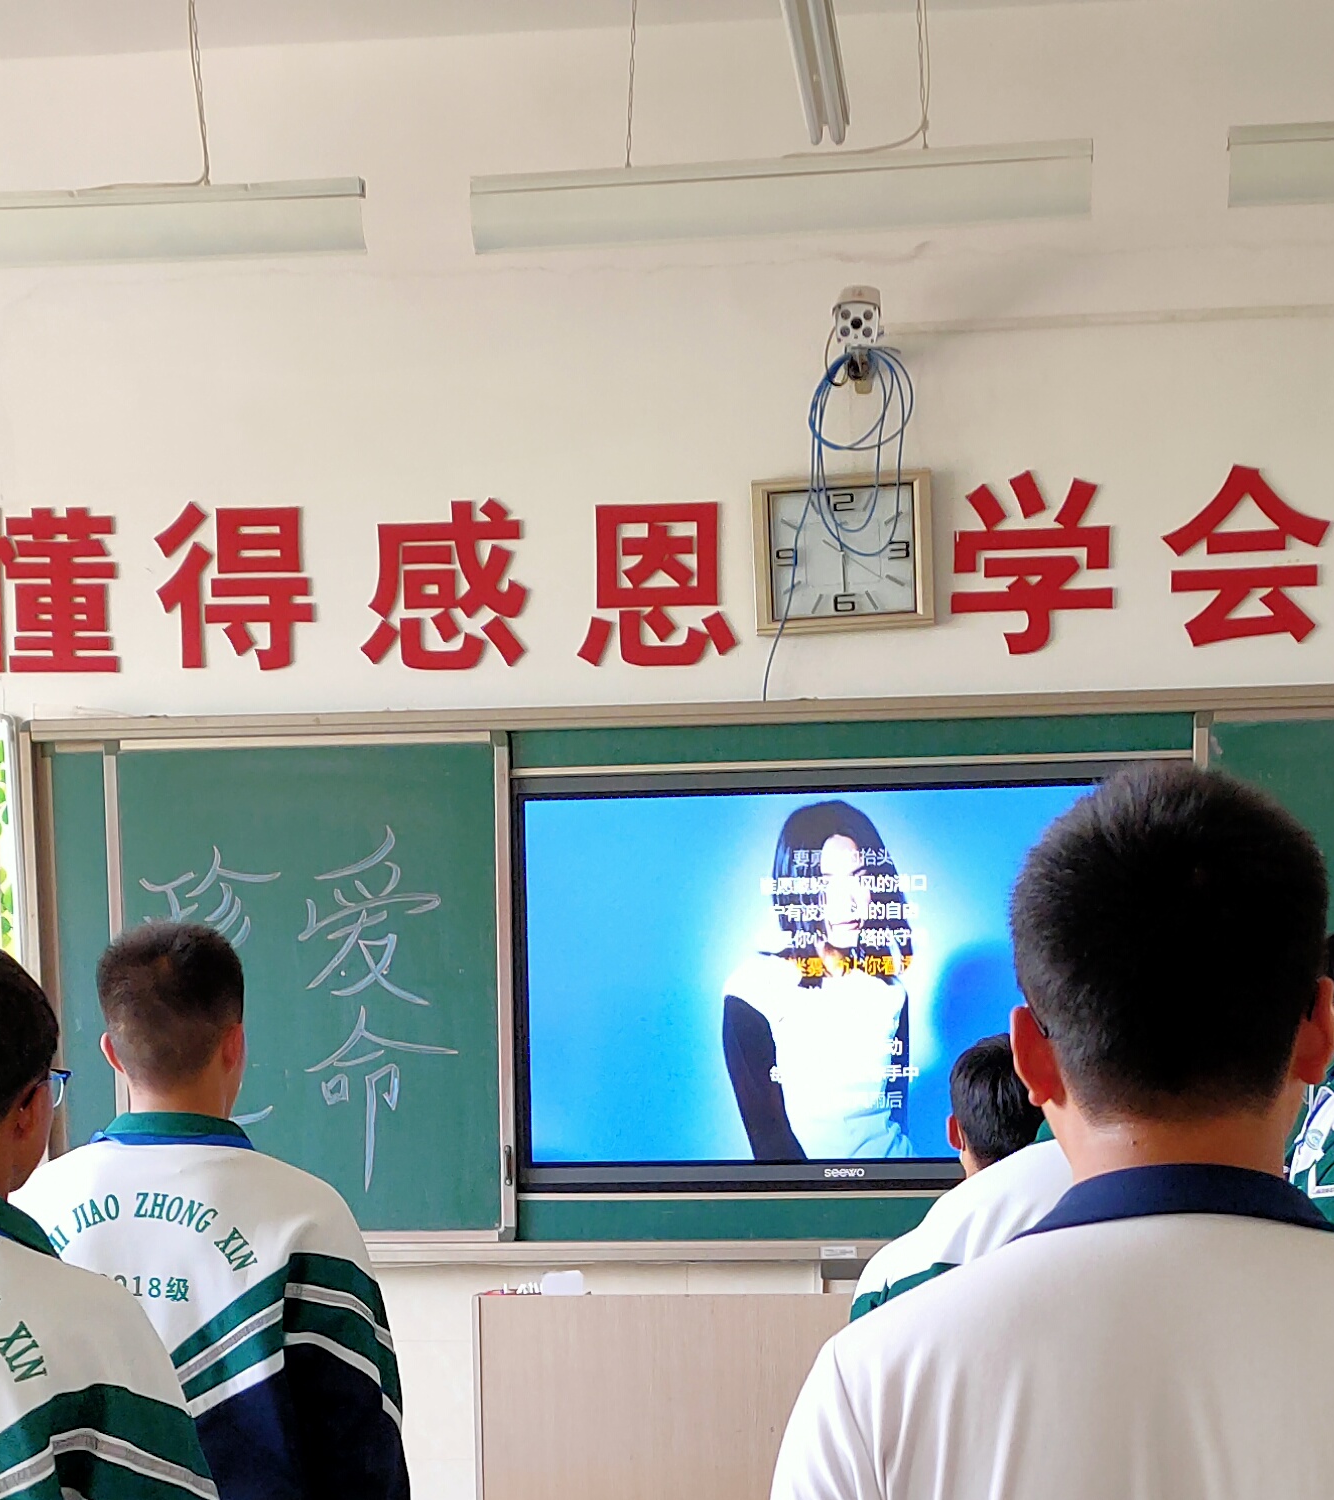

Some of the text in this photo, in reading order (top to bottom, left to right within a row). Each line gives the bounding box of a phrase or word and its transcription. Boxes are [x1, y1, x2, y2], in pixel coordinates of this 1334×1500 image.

[824, 1167, 865, 1178] seewo
[72, 1193, 121, 1234] JIAO
[133, 1192, 219, 1234] ZHONG
[213, 1226, 259, 1273] XIN
